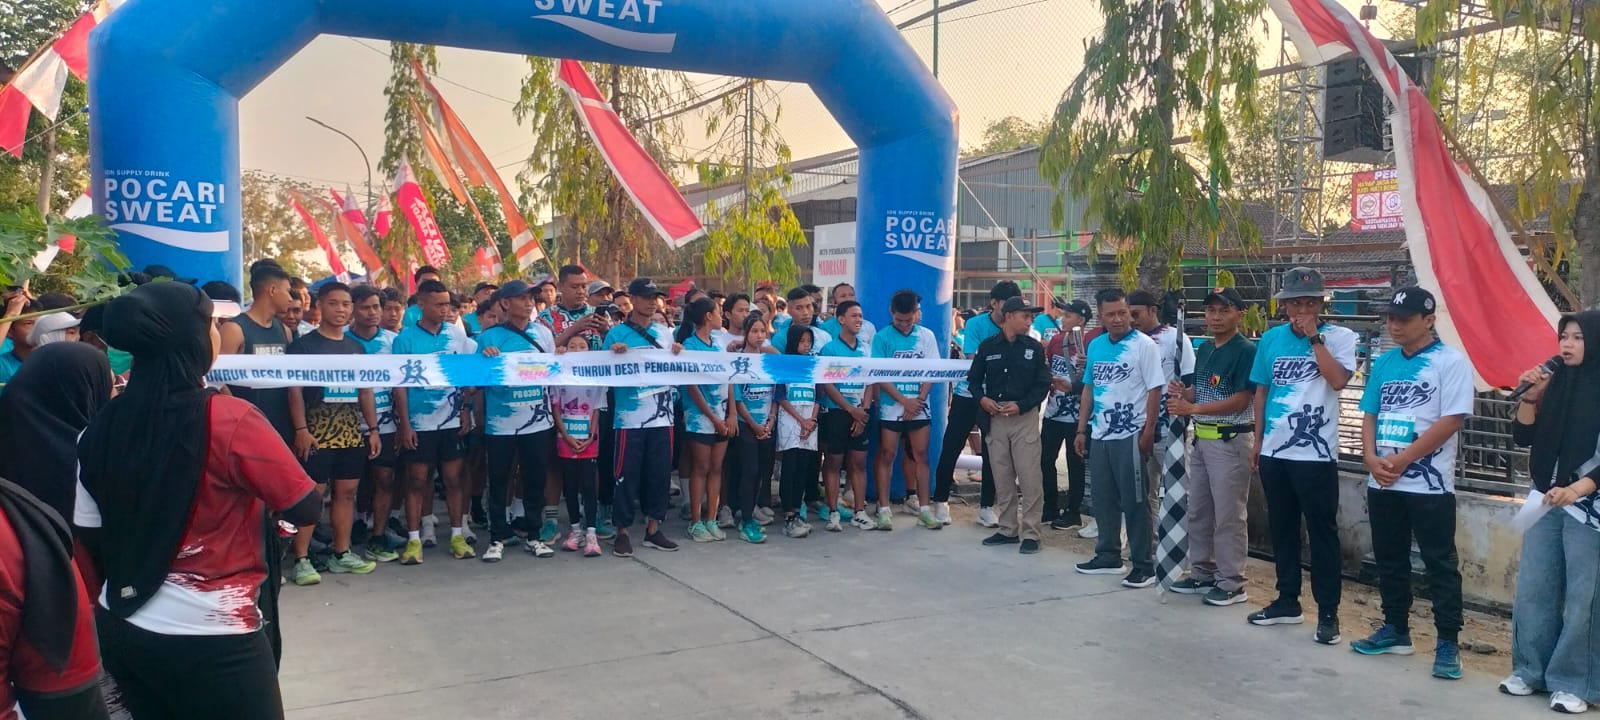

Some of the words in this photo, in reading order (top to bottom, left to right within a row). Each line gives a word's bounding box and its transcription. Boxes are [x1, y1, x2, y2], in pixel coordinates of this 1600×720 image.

[1374, 169, 1398, 180] PER
[104, 178, 224, 204] POCARI
[104, 200, 216, 225] SWEAT
[886, 216, 955, 235] POCAR
[572, 364, 611, 378] FUNRUN
[614, 363, 640, 376] DESA
[644, 361, 700, 374] PENGANTEN
[1093, 365, 1115, 374] FUN
[1273, 360, 1307, 371] FUN
[204, 369, 248, 383] UNRUN
[287, 369, 355, 382] PENGANTEN
[359, 369, 391, 382] 2026
[868, 368, 901, 378] FUNRUN
[902, 369, 924, 378] DESA
[924, 369, 970, 379] PENGANTE
[1272, 371, 1303, 380] RUN
[1381, 384, 1412, 396] FUN
[1381, 395, 1410, 405] RUN
[1388, 424, 1409, 438] 0247
